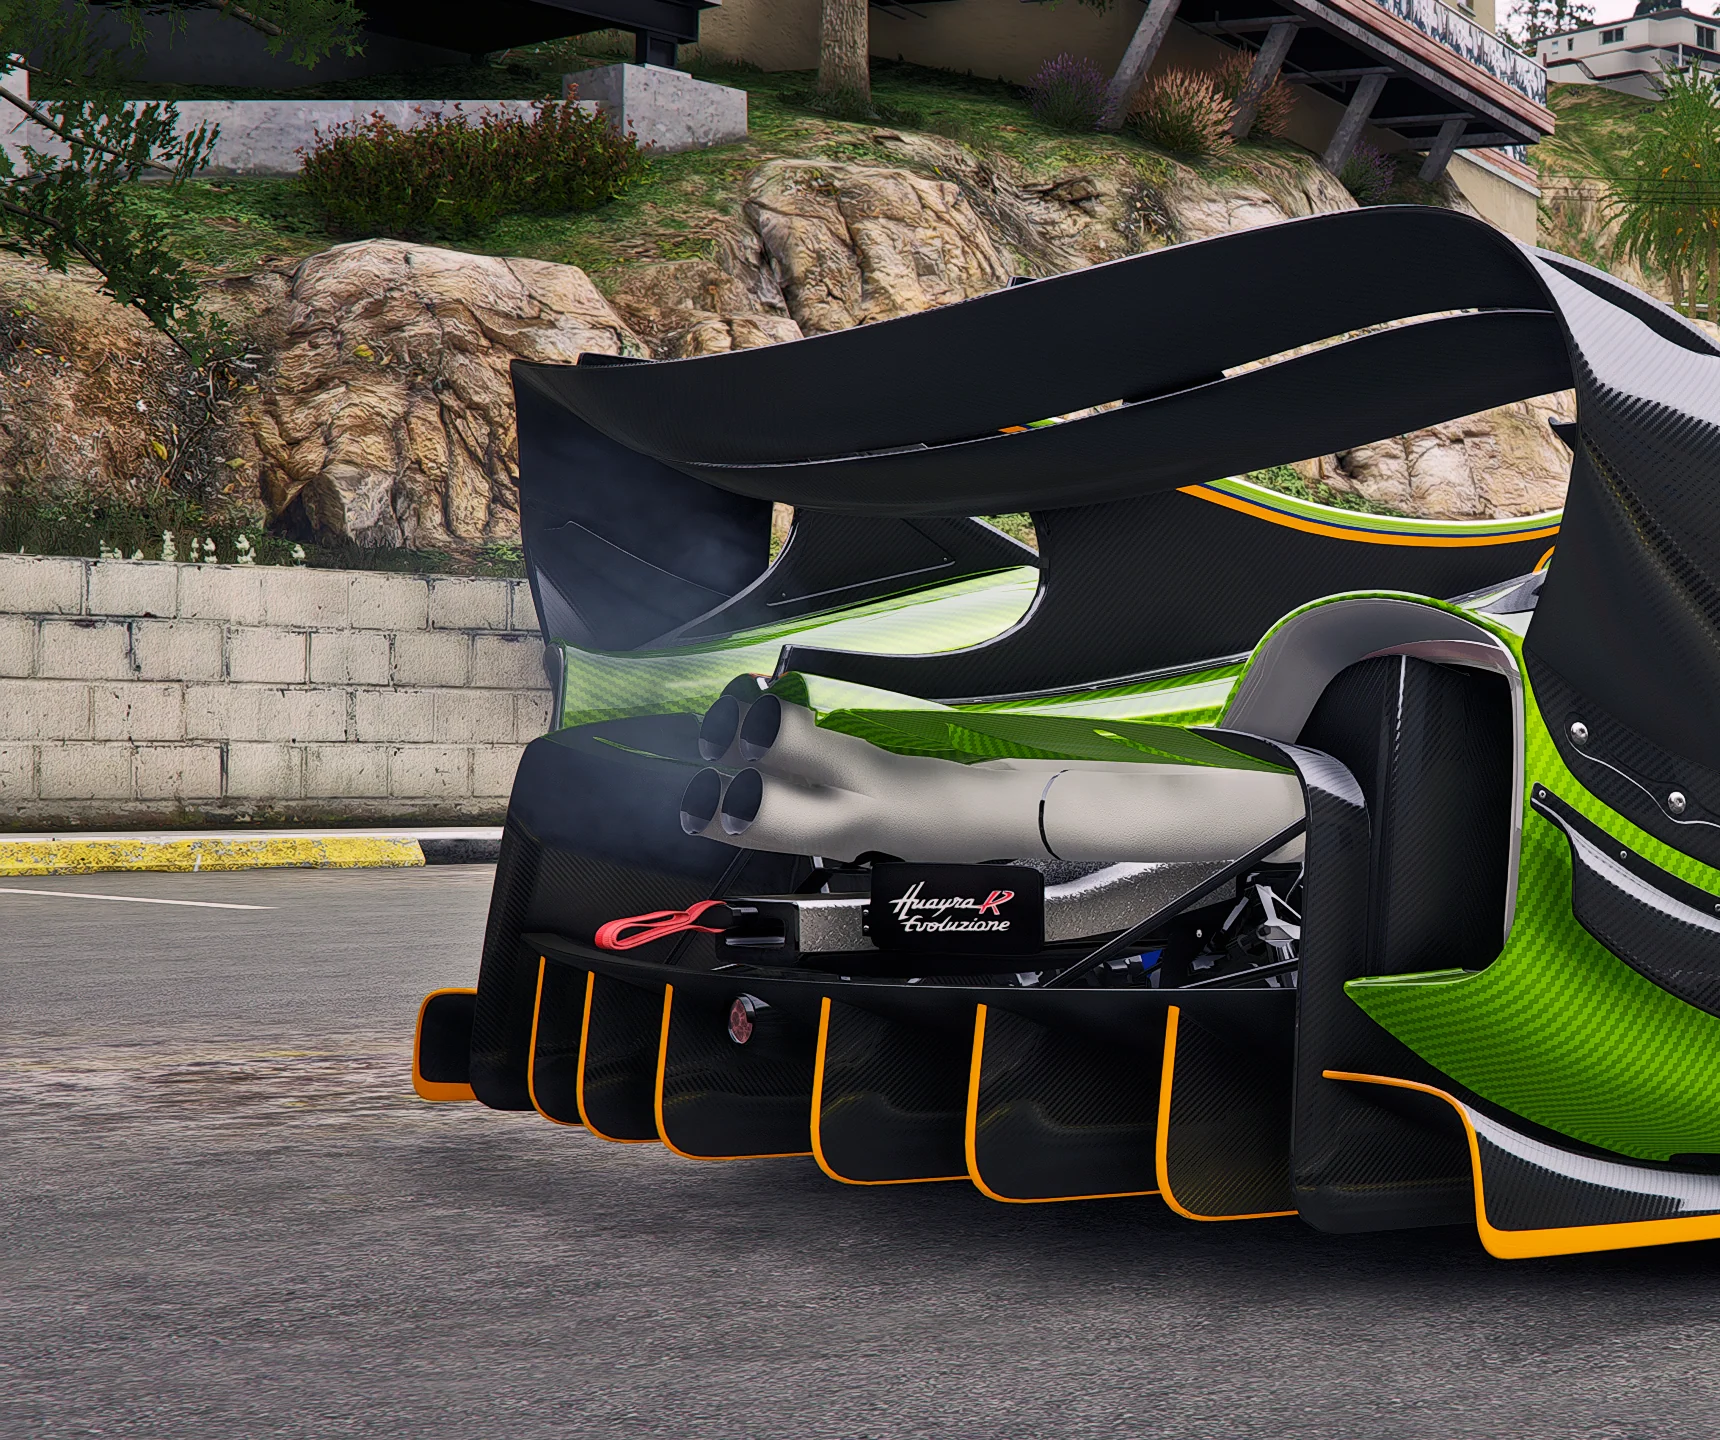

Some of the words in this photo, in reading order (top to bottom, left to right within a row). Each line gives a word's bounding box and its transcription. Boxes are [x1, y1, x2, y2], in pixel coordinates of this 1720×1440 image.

[889, 881, 981, 920] Huayra
[978, 890, 1015, 915] R
[900, 915, 1011, 932] Evoluzione
